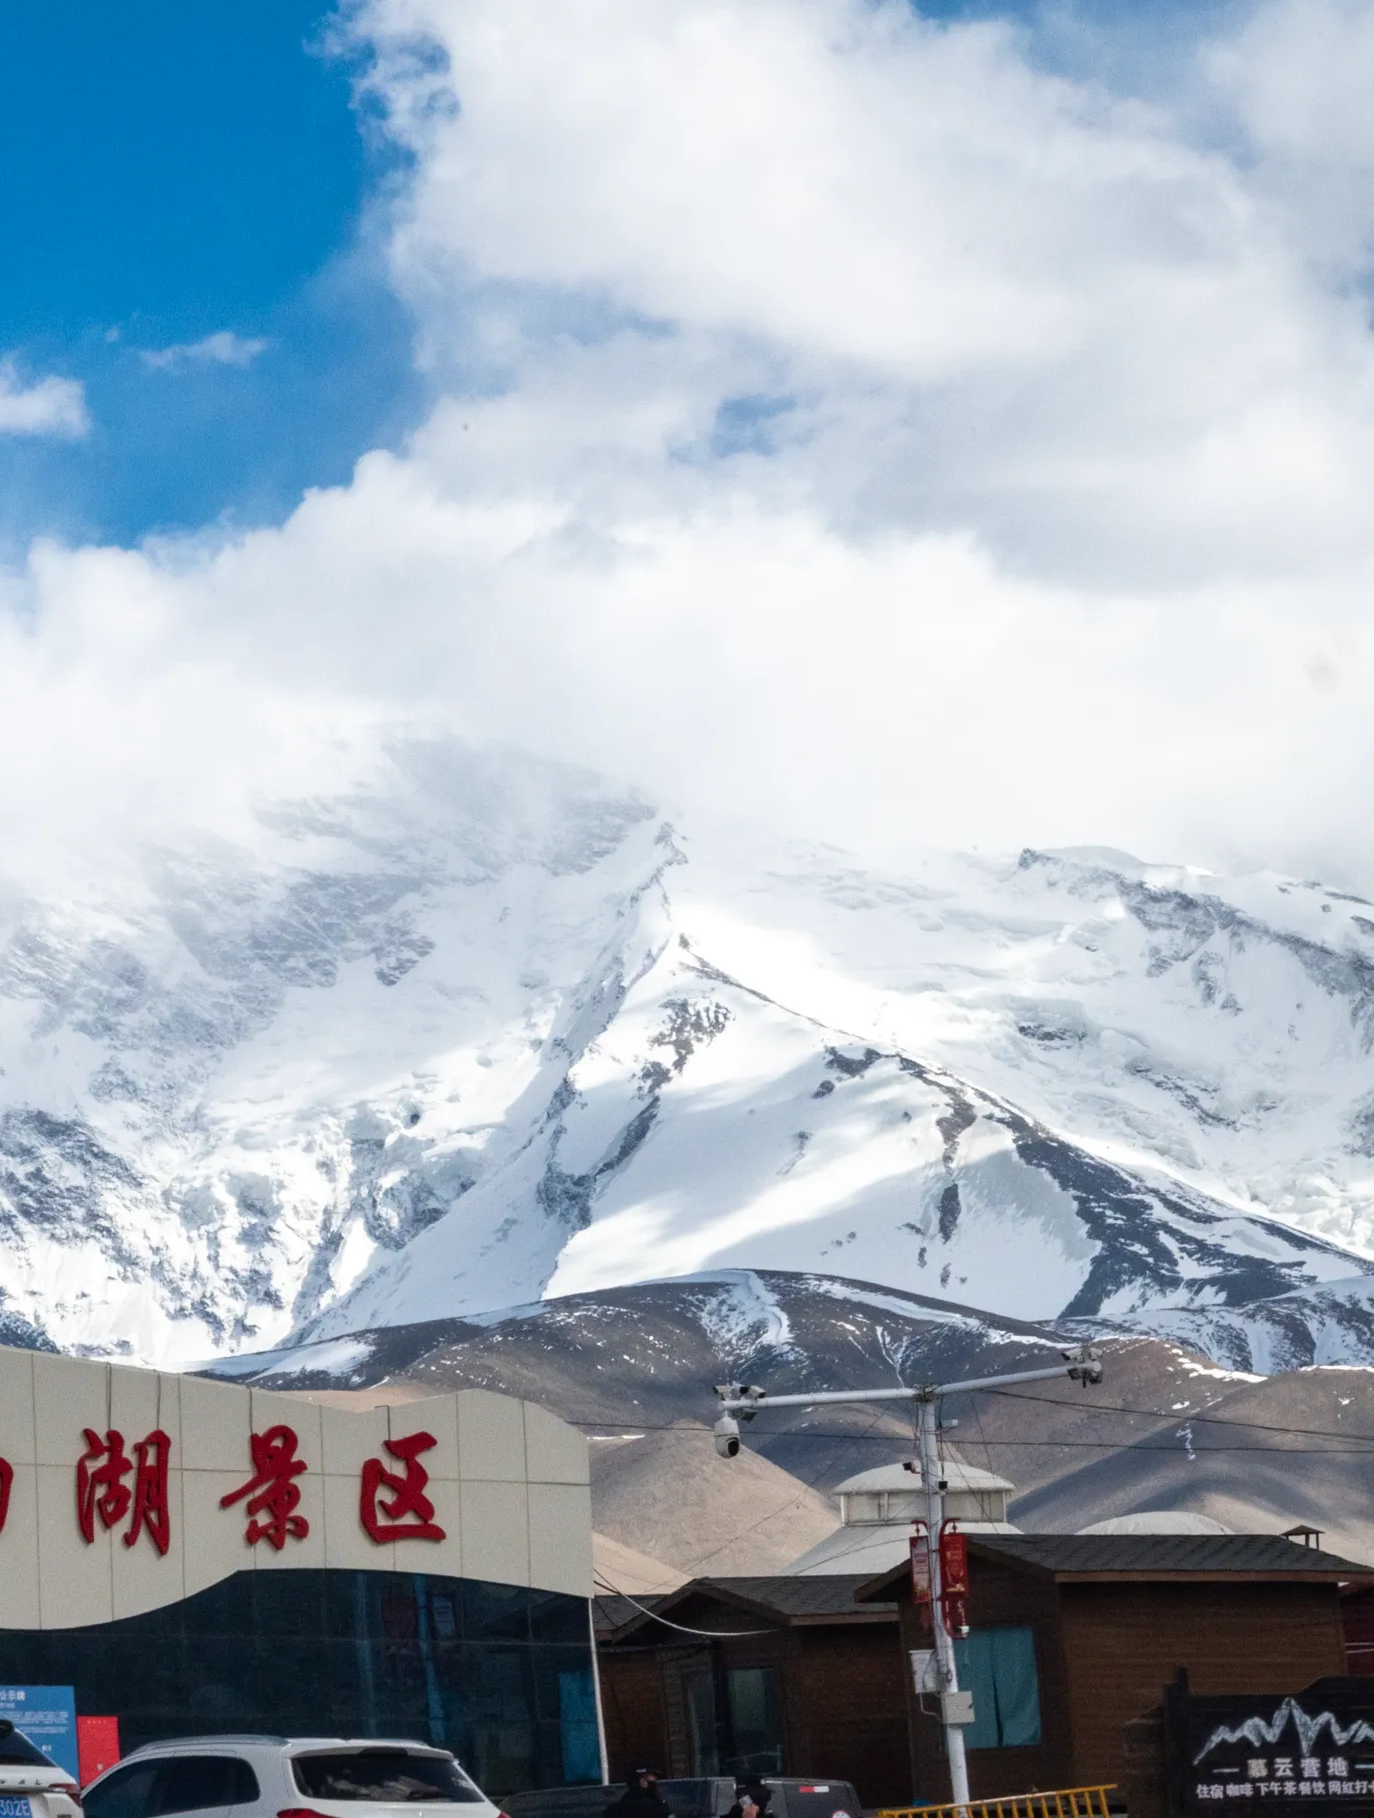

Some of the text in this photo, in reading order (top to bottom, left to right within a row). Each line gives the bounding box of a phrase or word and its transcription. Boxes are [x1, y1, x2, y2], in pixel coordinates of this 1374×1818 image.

[1196, 1784, 1224, 1799] 住宿
[1226, 1782, 1254, 1797] 咖啡
[1255, 1780, 1297, 1796] 下午茶
[1298, 1780, 1326, 1795] 餐饮
